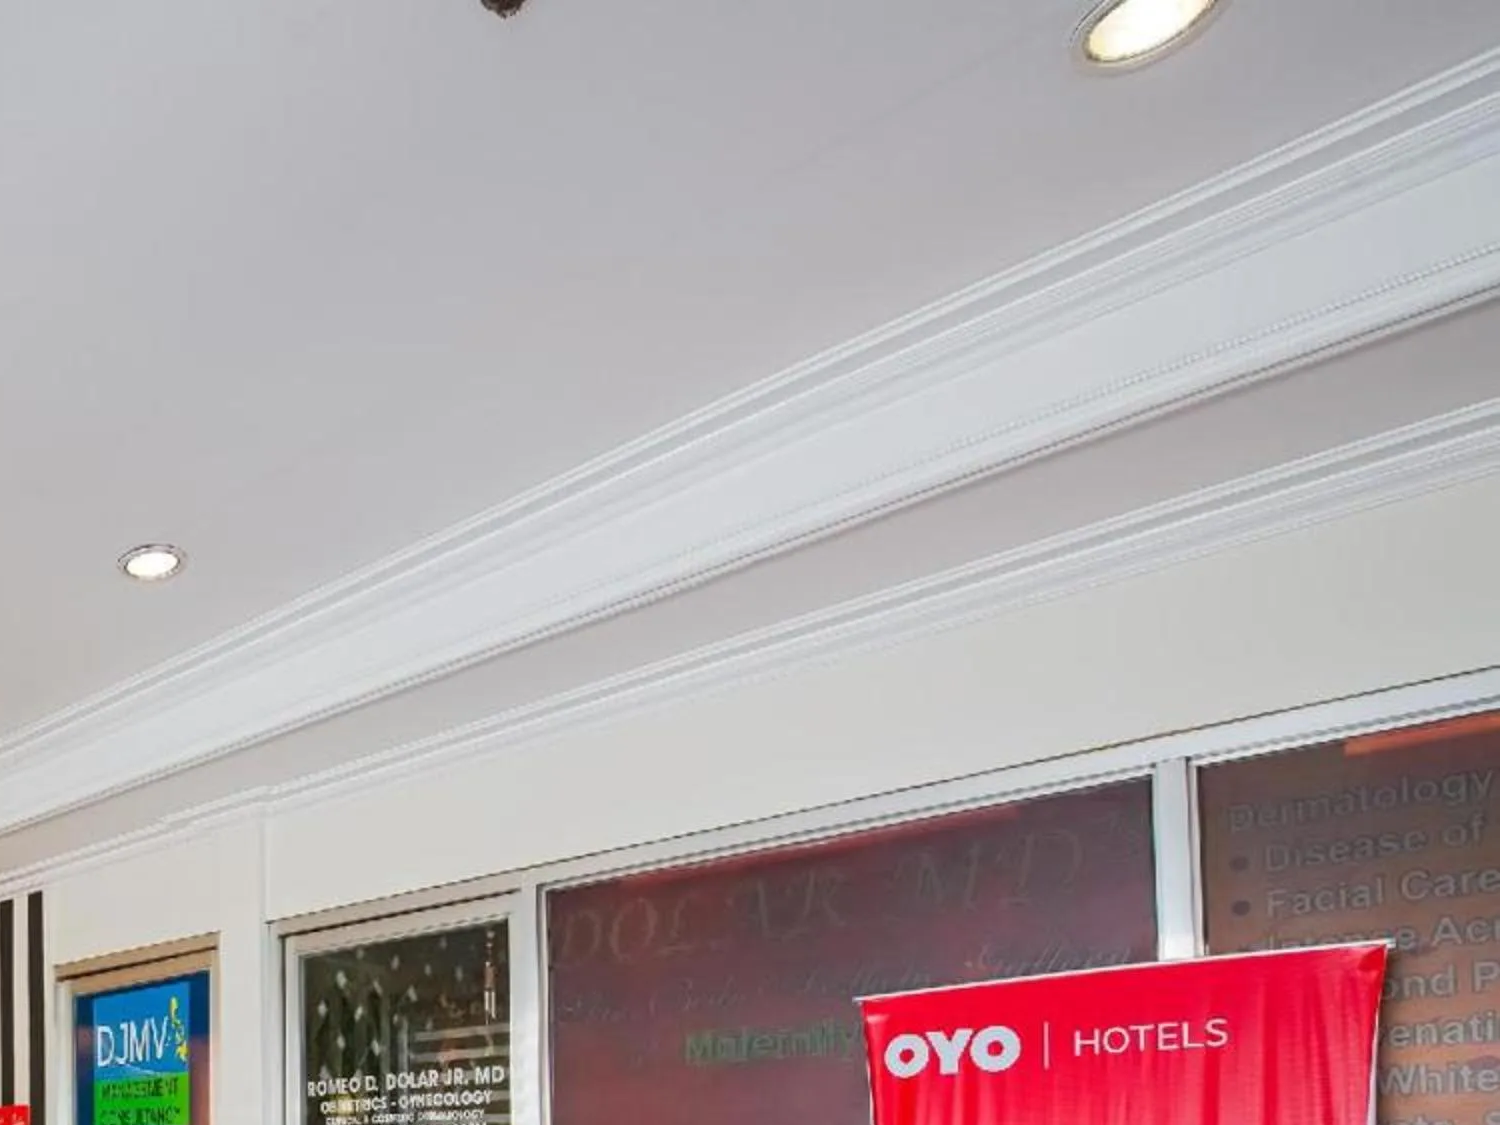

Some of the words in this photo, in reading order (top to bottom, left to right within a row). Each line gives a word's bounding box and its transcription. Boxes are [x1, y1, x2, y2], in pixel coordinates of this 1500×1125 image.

[1264, 829, 1428, 873] Disease
[1443, 809, 1488, 847] of
[1265, 875, 1386, 919] Facial
[1400, 866, 1500, 902] Care
[97, 1015, 169, 1068] DJMV
[883, 1025, 1022, 1079] OYO
[1073, 1018, 1230, 1057] HOTELS
[307, 1077, 361, 1097] ROMEO
[365, 1075, 379, 1092] D.
[385, 1070, 439, 1091] DOLAR
[444, 1067, 469, 1086] JR.
[475, 1066, 505, 1085] MD
